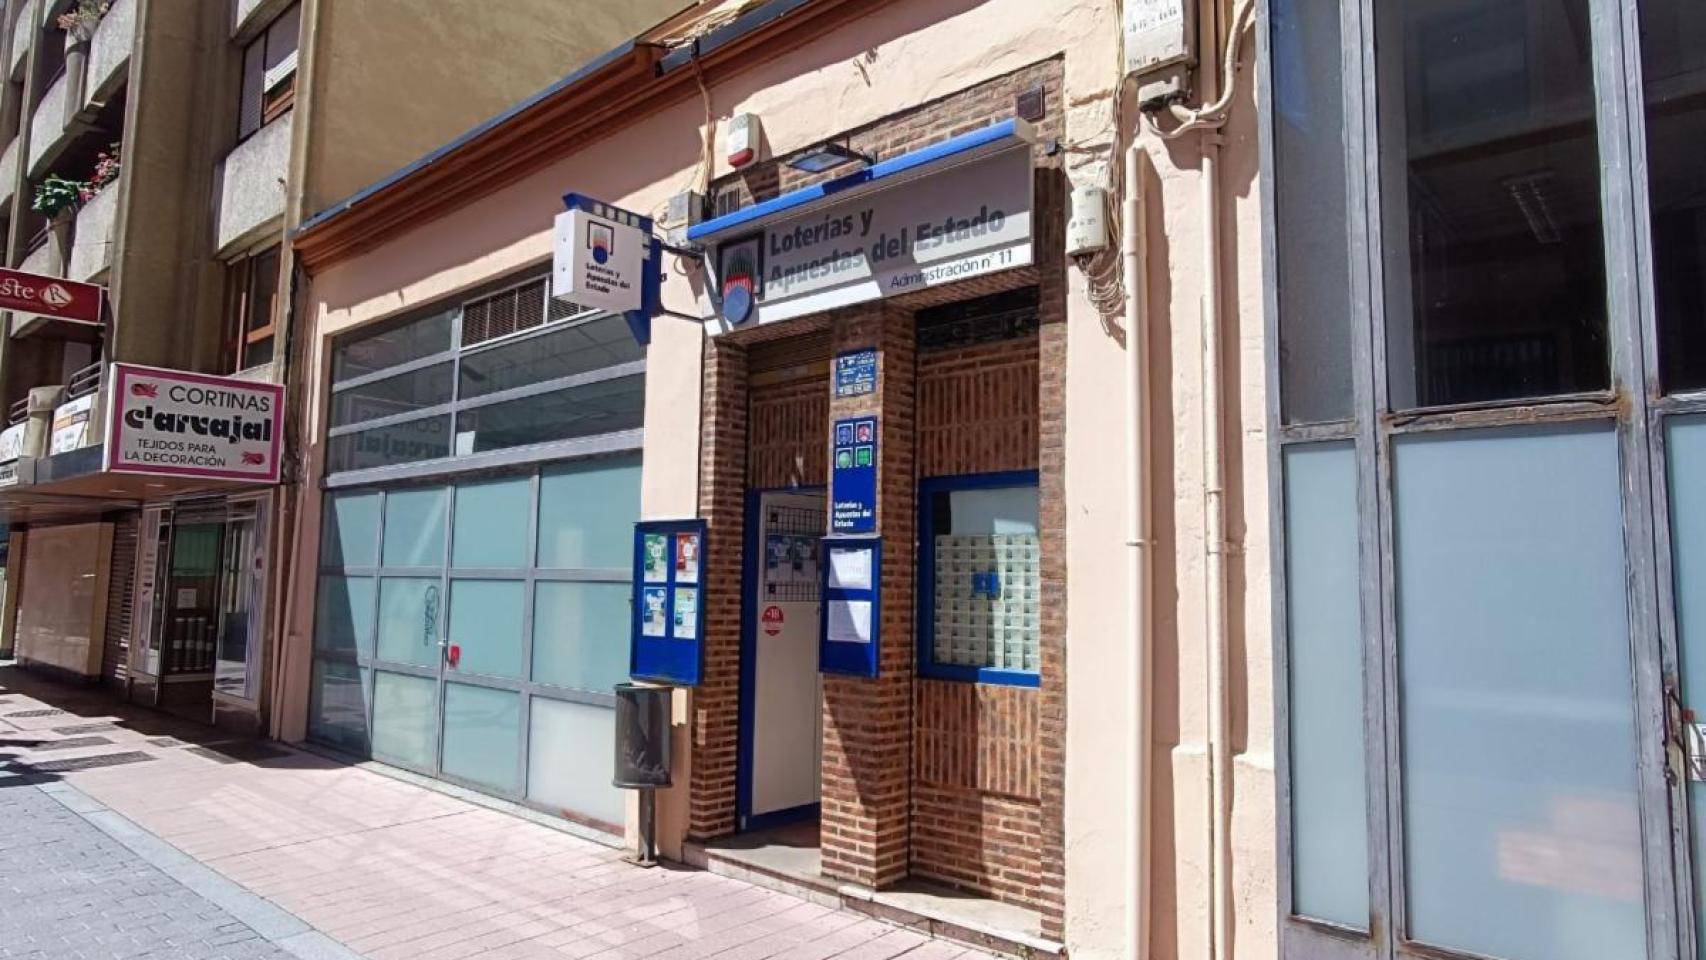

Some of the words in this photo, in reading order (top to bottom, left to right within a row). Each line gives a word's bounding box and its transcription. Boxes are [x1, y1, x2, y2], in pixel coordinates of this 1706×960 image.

[770, 213, 854, 257] Loterías
[861, 207, 874, 237] y
[768, 246, 864, 293] Apuestas
[871, 226, 908, 263] del
[916, 204, 1005, 252] Estado
[890, 258, 979, 288] Administración
[998, 248, 1012, 264] 11
[0, 278, 36, 300] ste
[586, 272, 617, 287] Apuestas
[619, 280, 631, 289] del
[586, 280, 610, 293] Estado
[168, 384, 271, 412] CORTINAS
[137, 438, 185, 452] TEJIDOS
[187, 442, 217, 454] PARA
[124, 450, 140, 461] LA
[143, 450, 227, 467] DECORACIÓN
